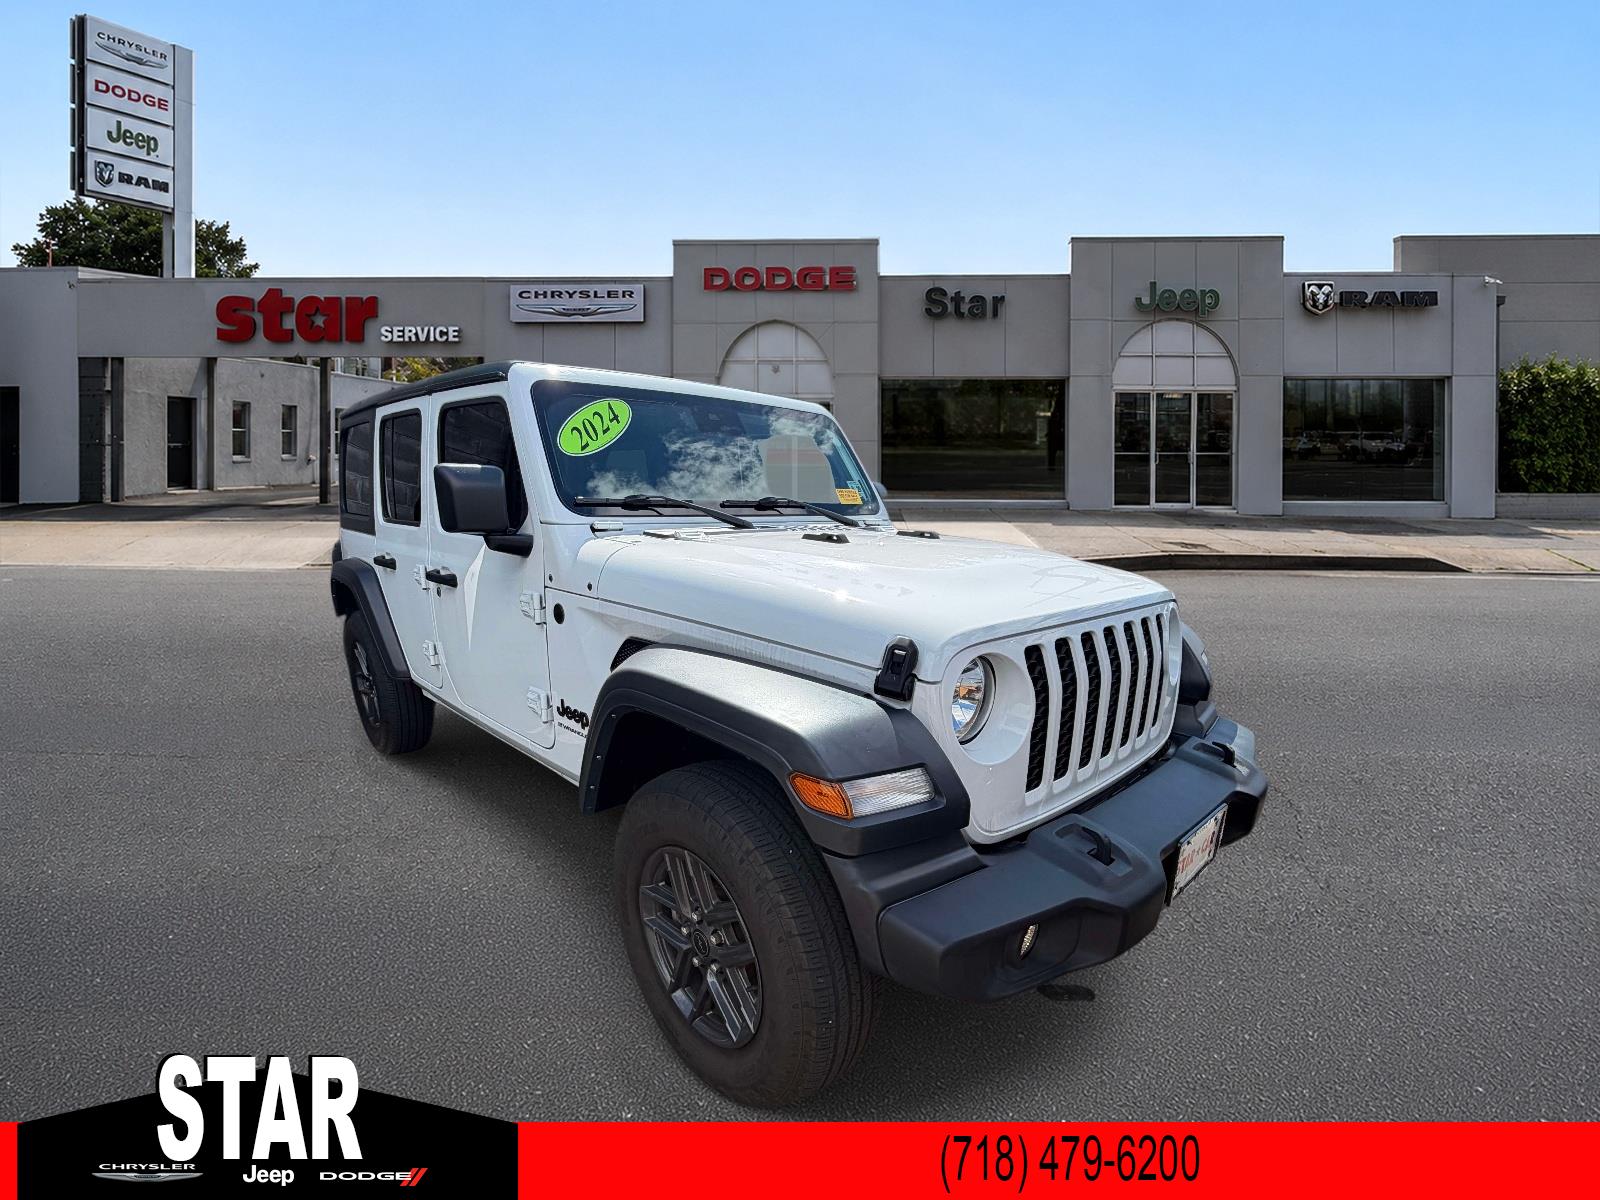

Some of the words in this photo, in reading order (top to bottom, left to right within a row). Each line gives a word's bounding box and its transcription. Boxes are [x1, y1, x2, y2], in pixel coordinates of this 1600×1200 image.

[97, 31, 168, 61] CHRYSLER
[94, 79, 169, 112] DODGE
[107, 120, 158, 156] Jeep
[118, 172, 169, 193] RAM
[517, 289, 636, 300] CHRYSLER
[703, 266, 857, 292] DODGE
[924, 286, 1007, 320] Star
[1135, 281, 1220, 317] Jeep
[1339, 290, 1439, 307] RAM
[215, 287, 379, 344] star
[380, 326, 461, 343] SERVICE
[570, 402, 621, 451] 2024
[556, 698, 590, 730] Jeep
